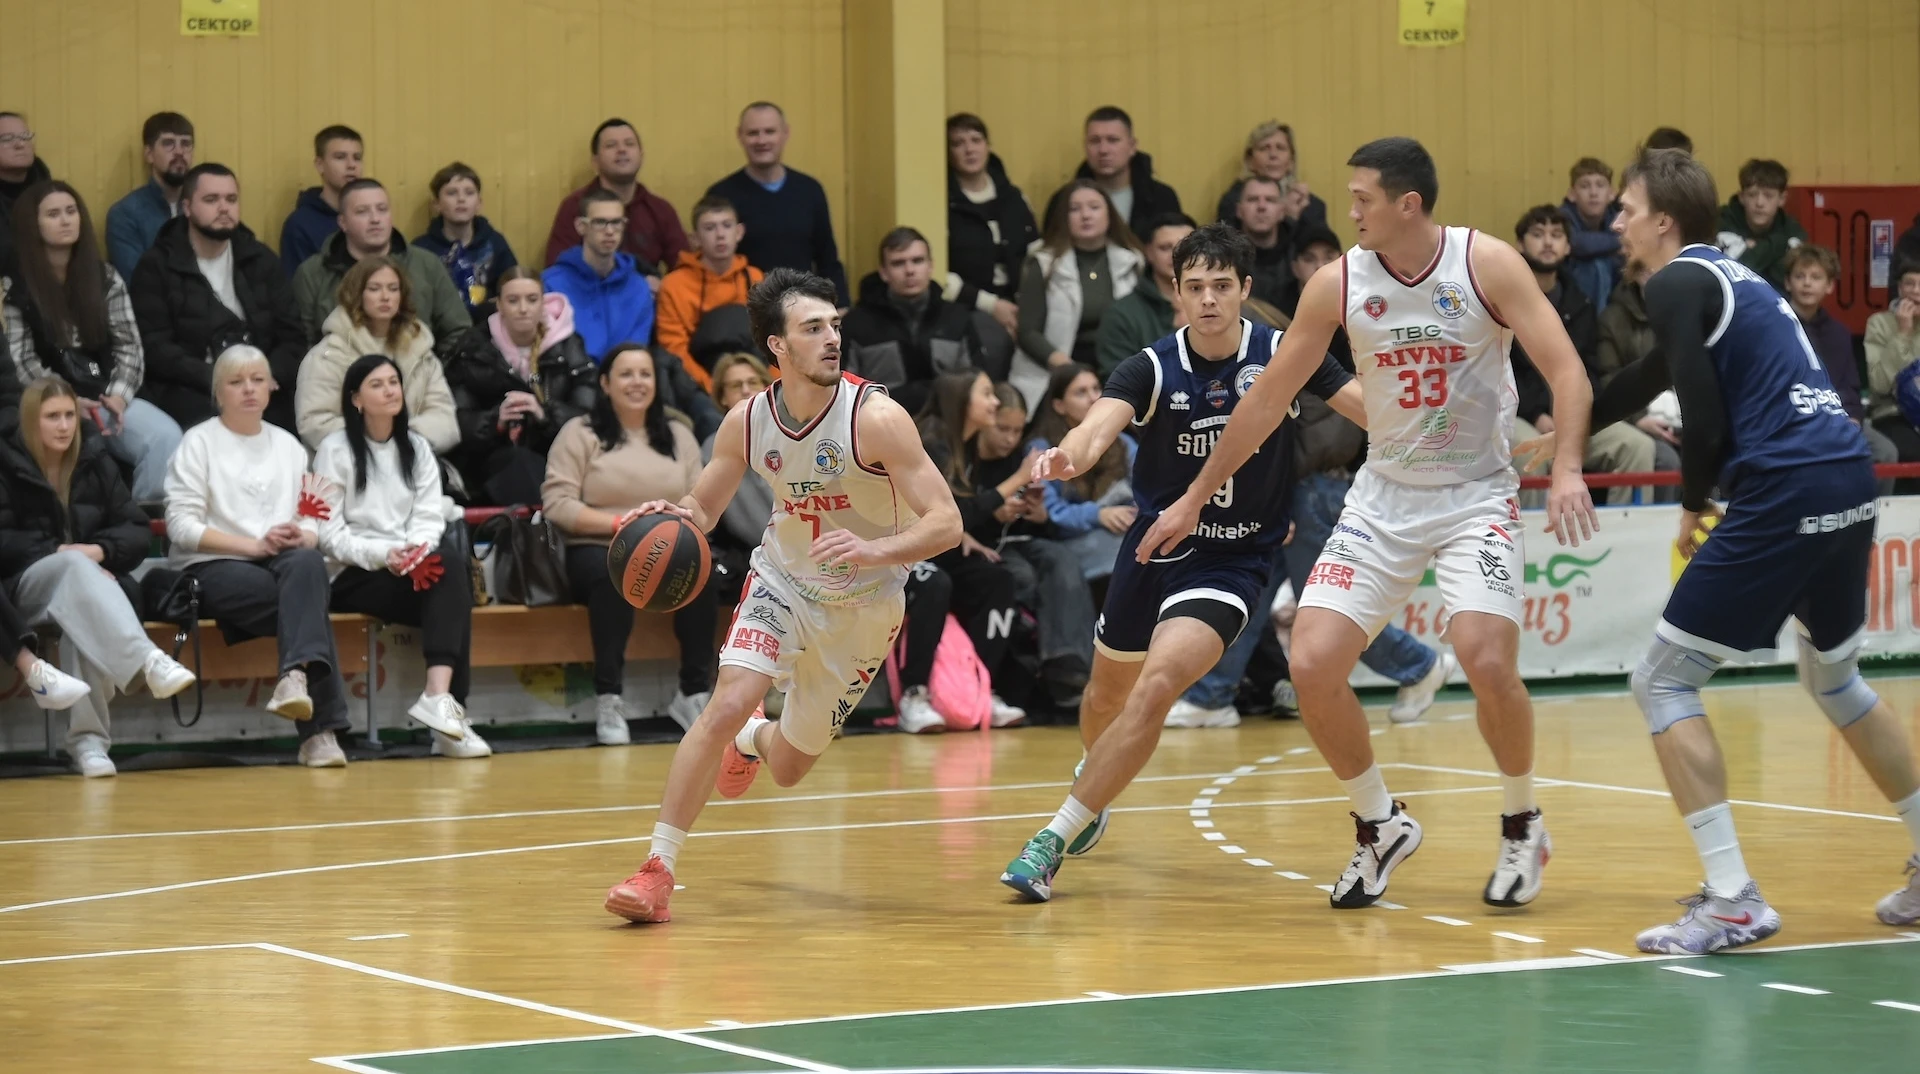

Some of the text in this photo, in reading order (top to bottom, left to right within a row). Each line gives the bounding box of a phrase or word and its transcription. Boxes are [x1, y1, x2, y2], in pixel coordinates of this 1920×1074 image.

[1424, 1, 1436, 17] 7
[187, 18, 253, 32] СЕКТОР
[1403, 28, 1459, 41] СЕКТОР
[1390, 324, 1442, 341] TBG
[1374, 345, 1467, 368] RIVNE
[1397, 367, 1449, 410] 33
[799, 512, 821, 541] 7
[629, 536, 670, 601] SPALDING
[1311, 562, 1355, 580] NTER
[665, 567, 687, 597] FBU
[1484, 578, 1515, 592] VECTOR
[1487, 585, 1517, 599] GLOBAL
[736, 627, 780, 652] INTER
[732, 638, 780, 663] BETON
